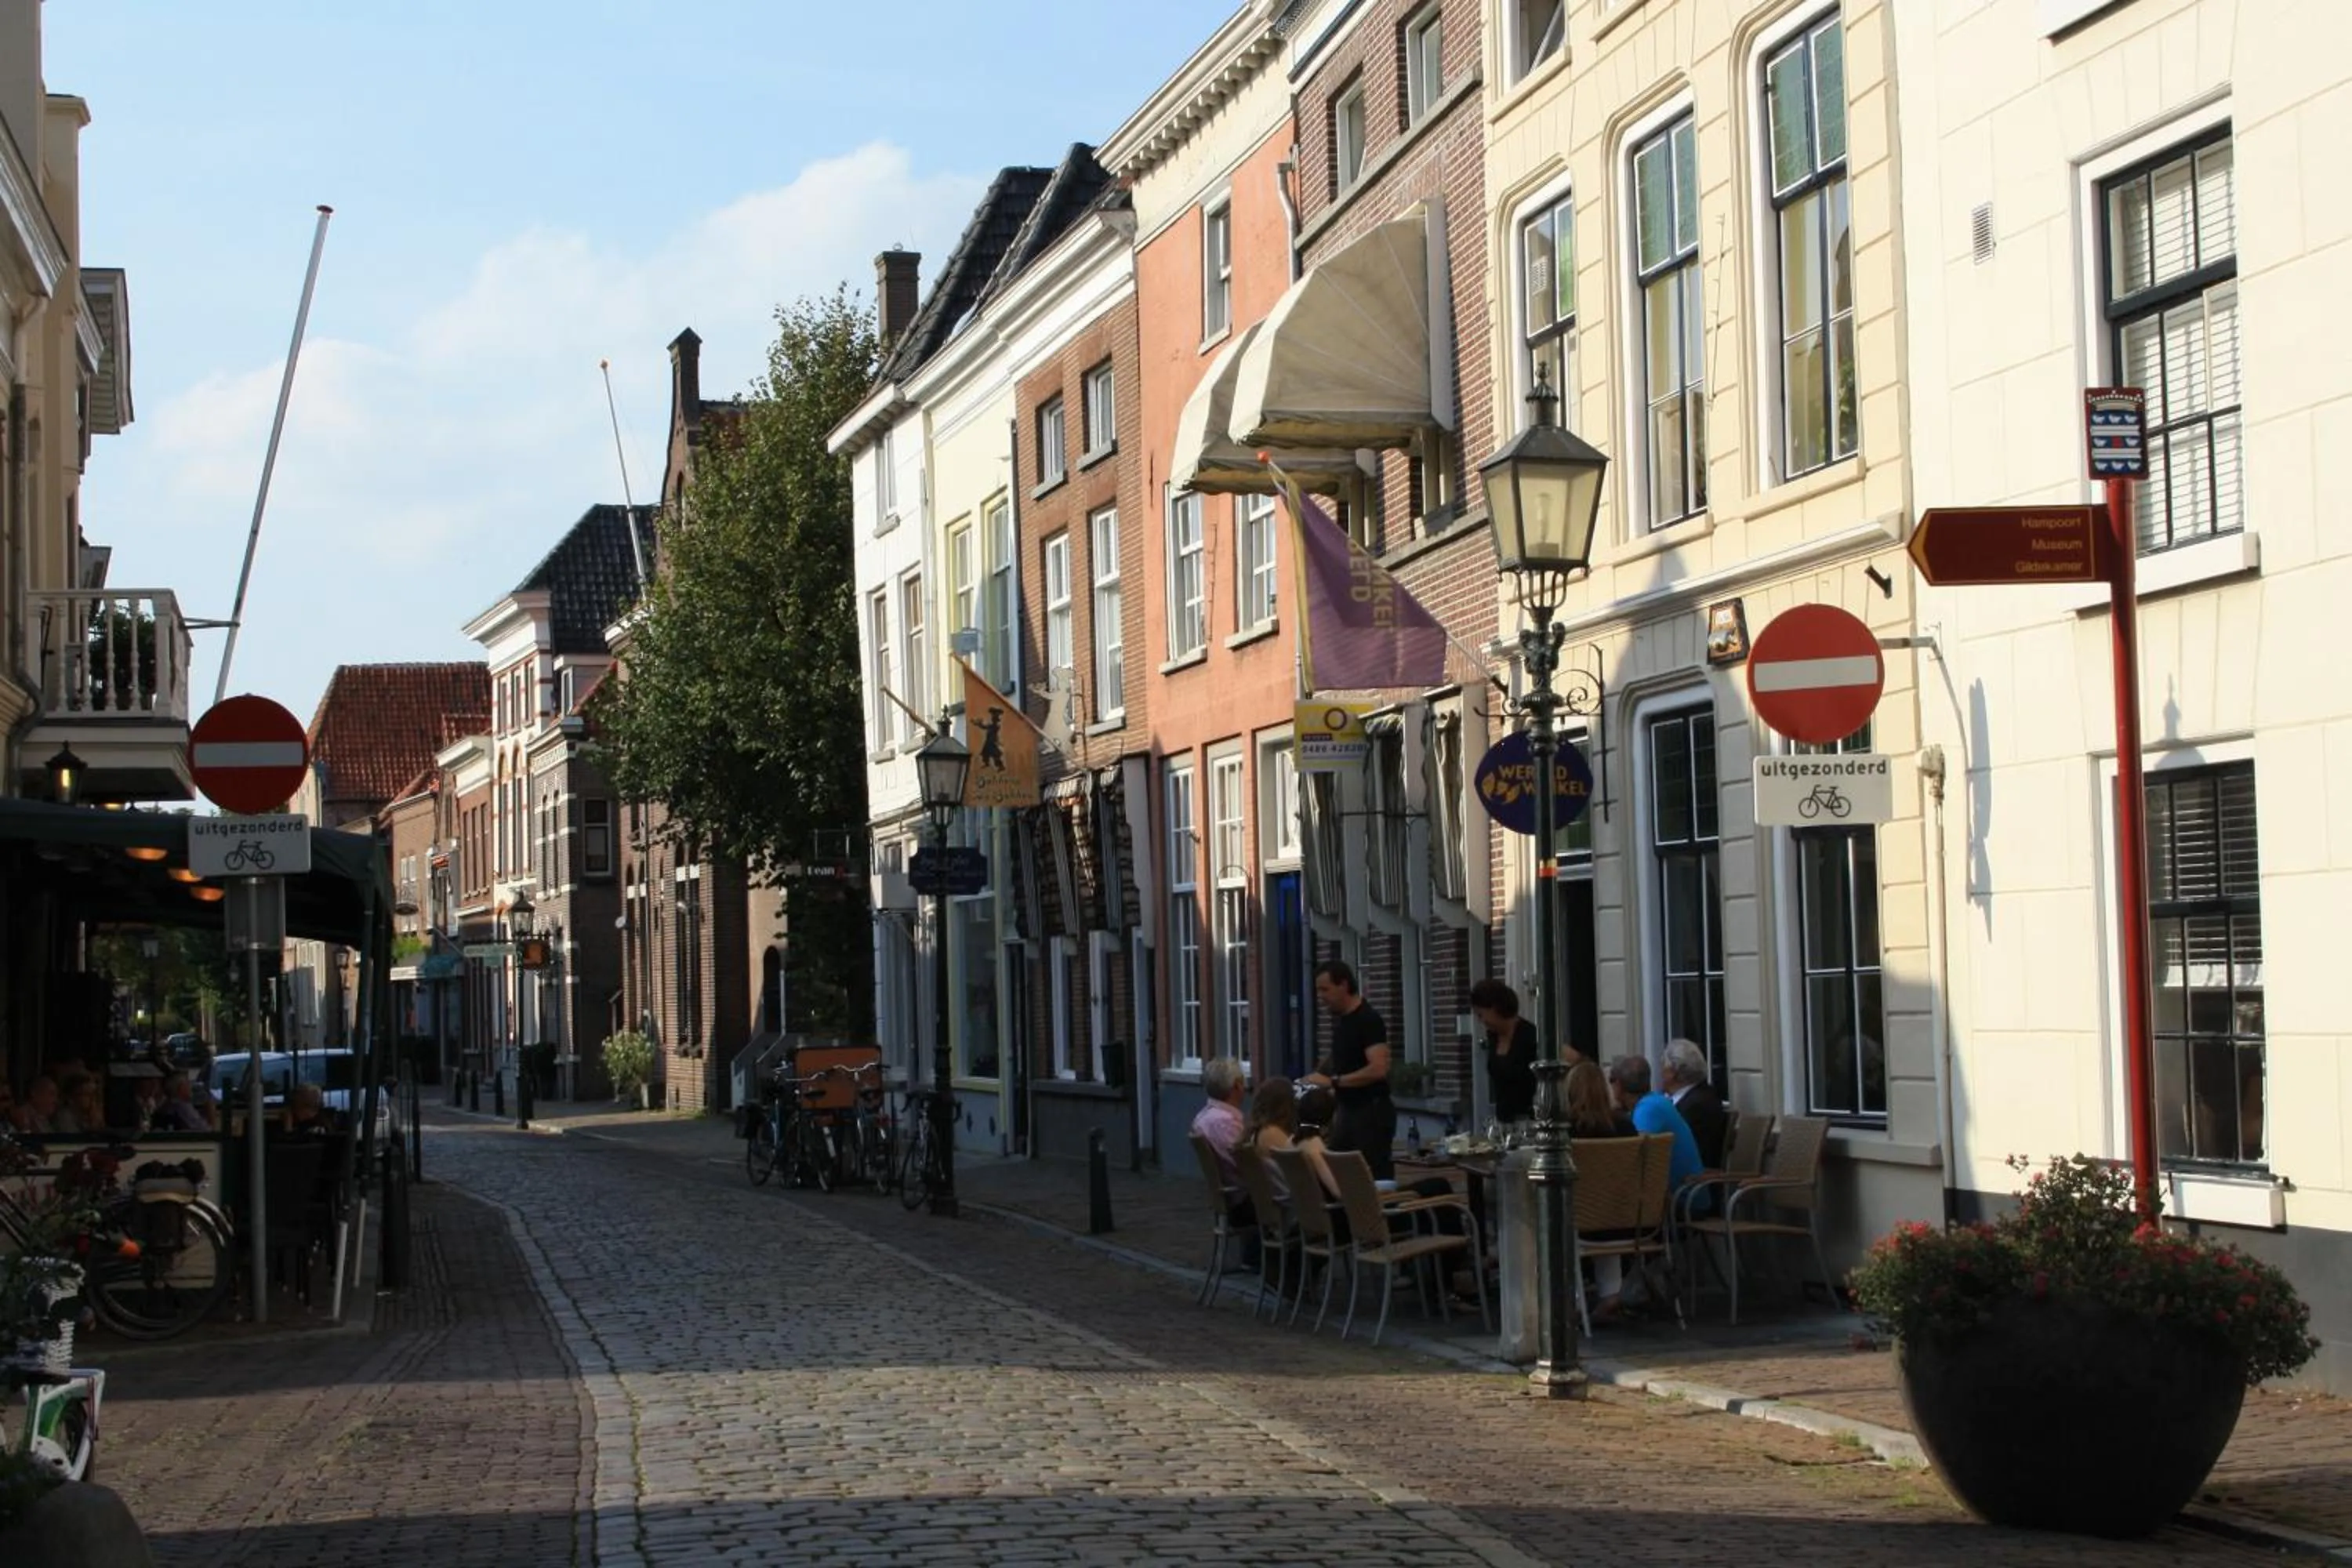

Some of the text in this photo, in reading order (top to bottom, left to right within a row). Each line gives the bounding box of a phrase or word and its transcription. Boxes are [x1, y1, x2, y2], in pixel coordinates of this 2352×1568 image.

[2021, 517, 2082, 529] Hampoort
[2031, 539, 2082, 550] Museum
[1498, 764, 1567, 780] WERD
[1761, 760, 1886, 780] uitgezonderd
[194, 819, 303, 837] uitgezonderd
